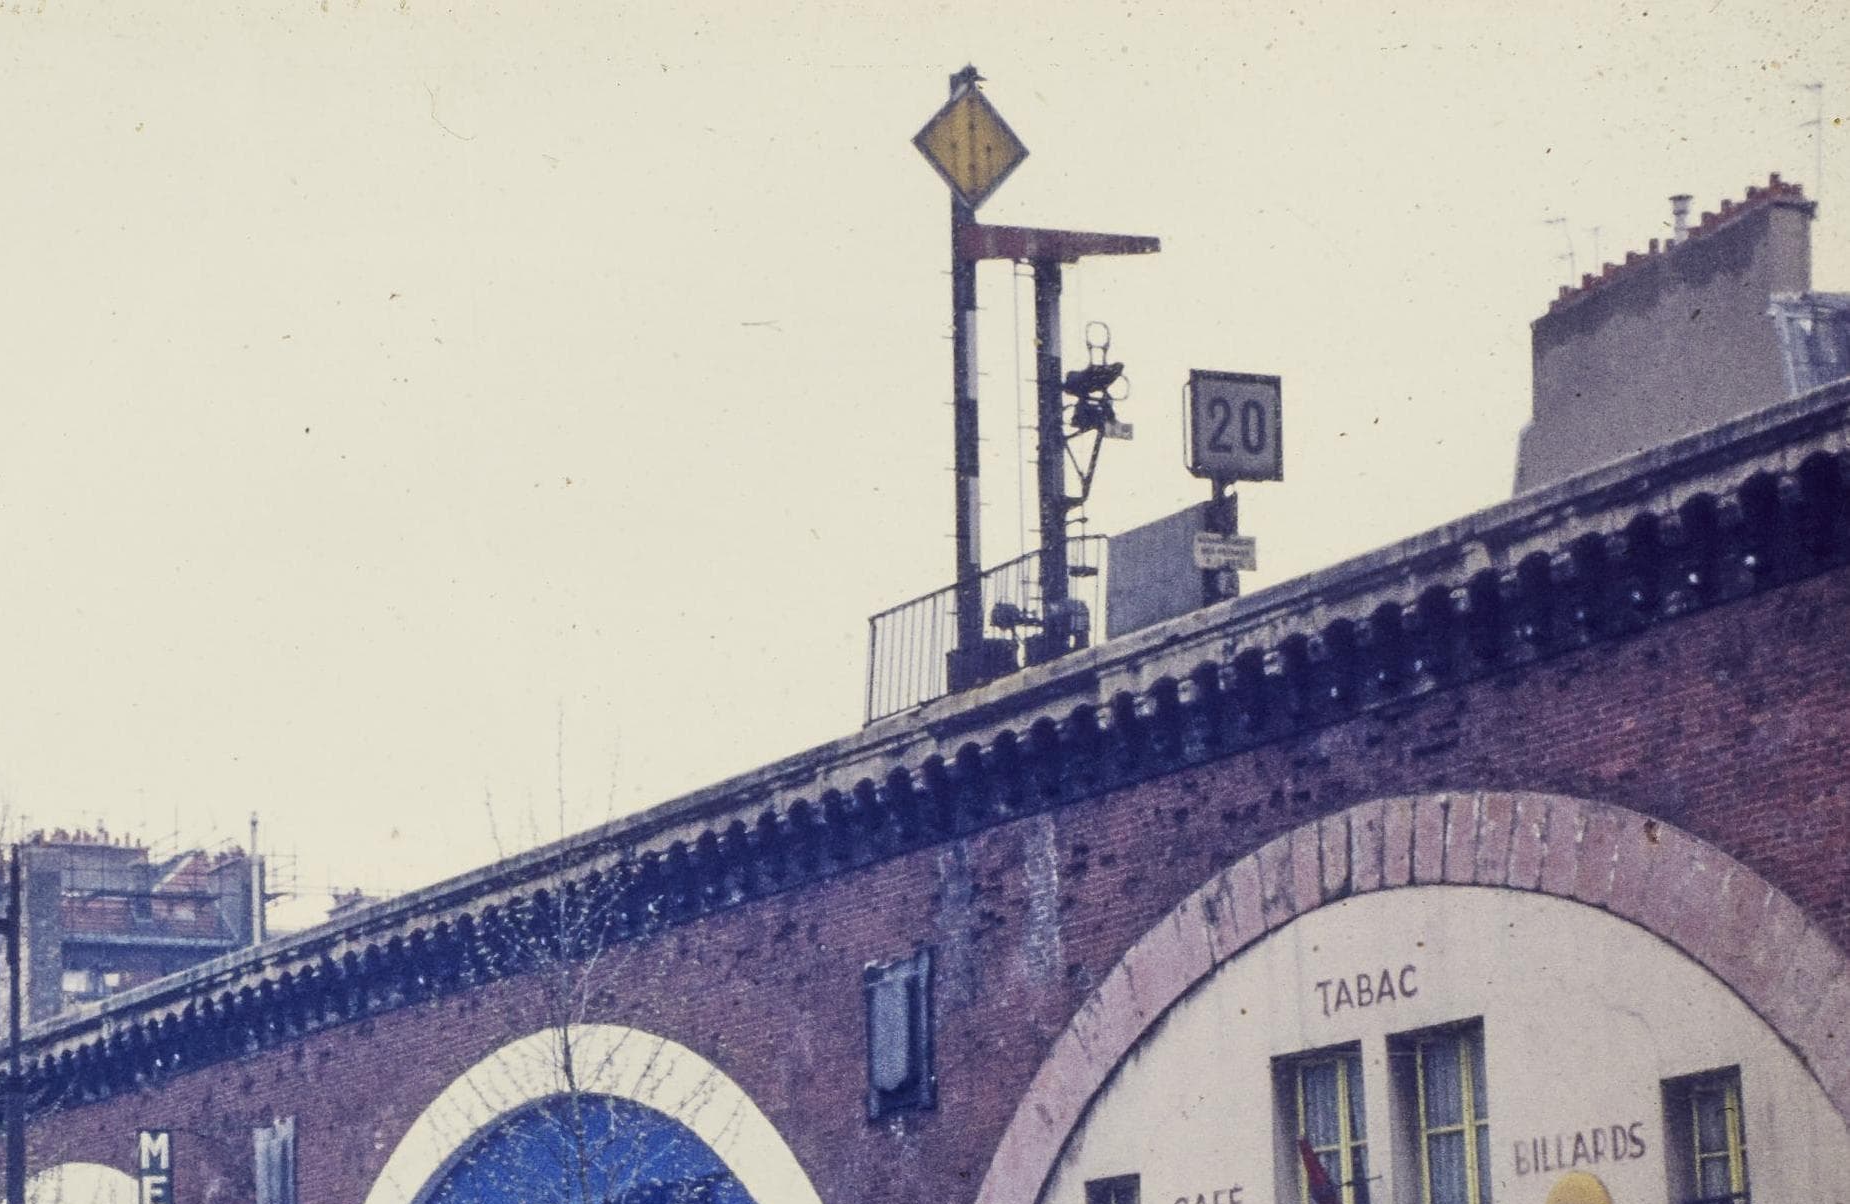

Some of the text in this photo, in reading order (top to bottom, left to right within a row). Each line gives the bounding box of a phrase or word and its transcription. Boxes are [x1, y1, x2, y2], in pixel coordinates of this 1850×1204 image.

[1208, 398, 1266, 455] 20
[1314, 964, 1418, 1017] TABAC
[1513, 1121, 1646, 1175] BILLARDS
